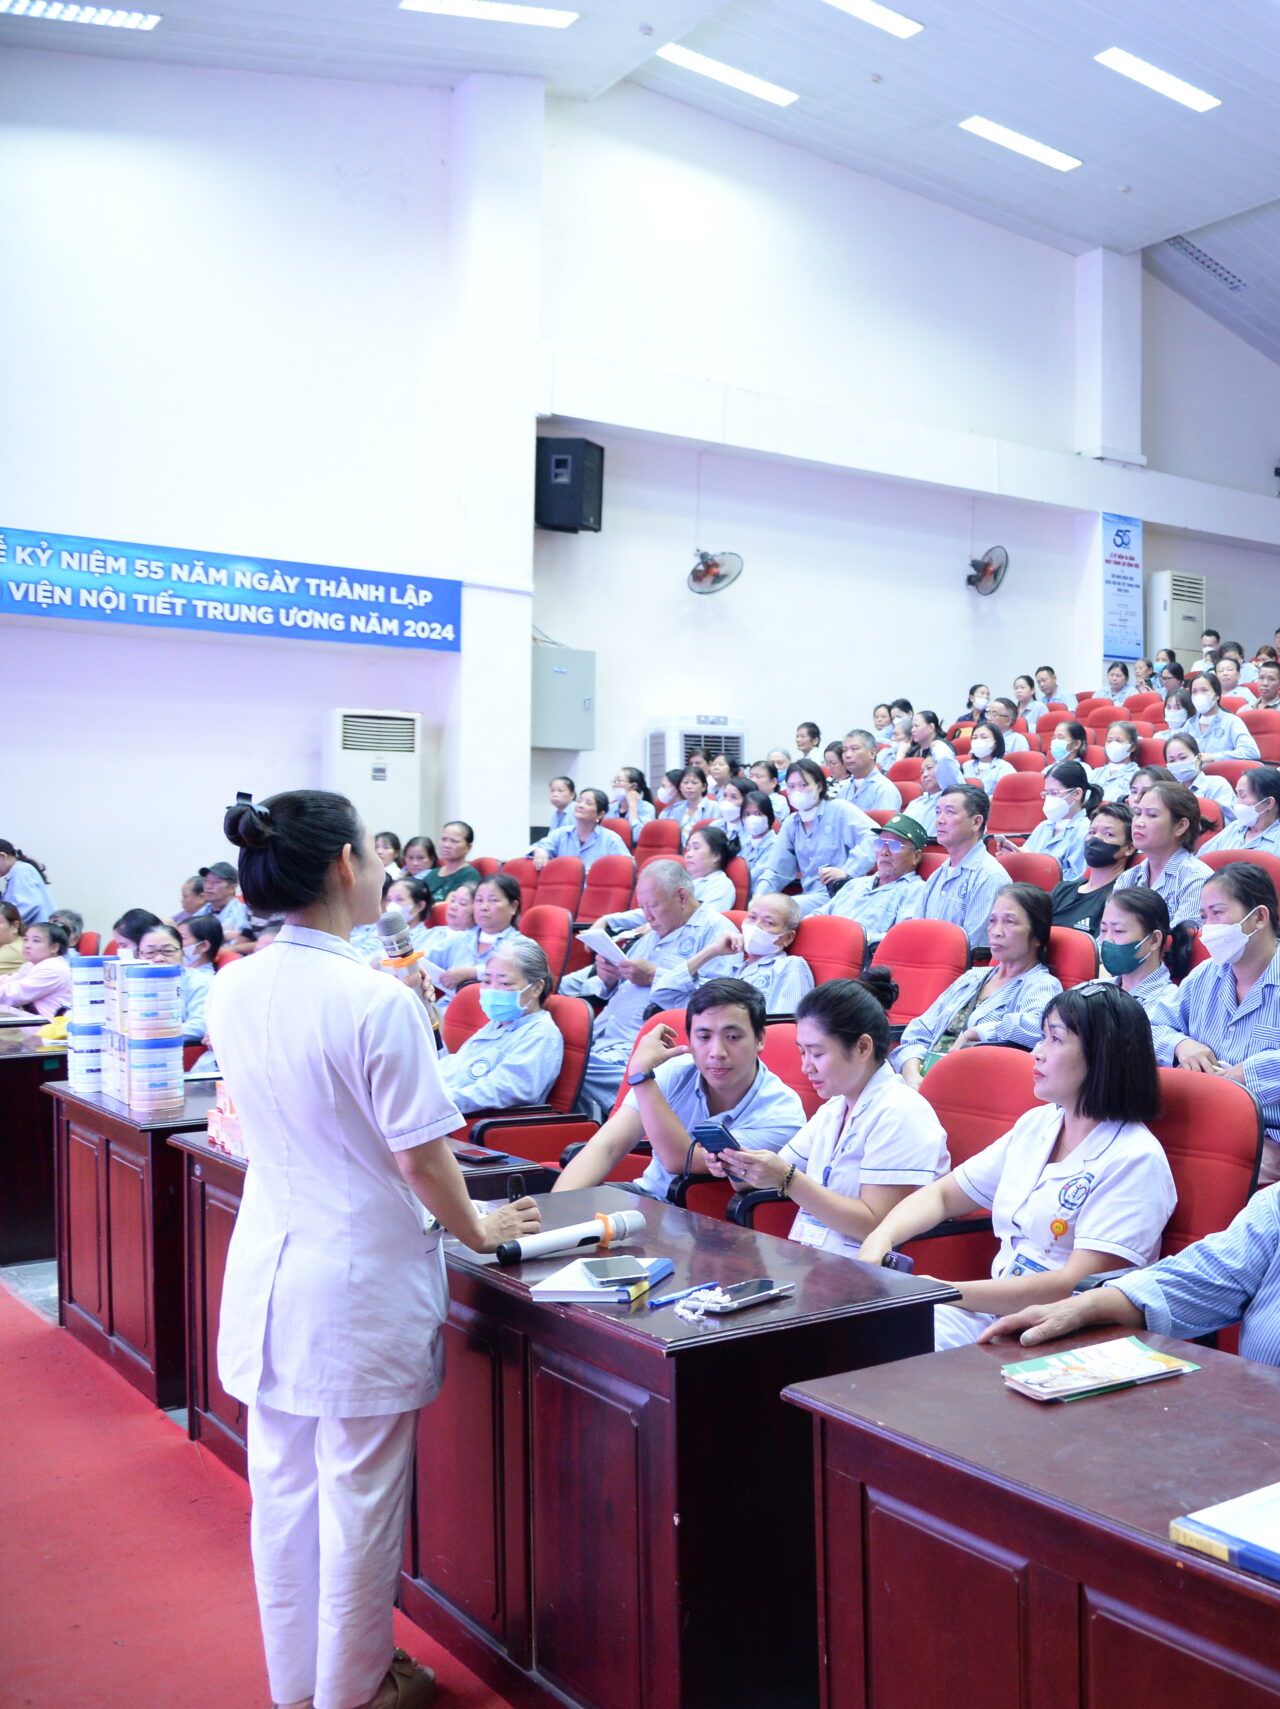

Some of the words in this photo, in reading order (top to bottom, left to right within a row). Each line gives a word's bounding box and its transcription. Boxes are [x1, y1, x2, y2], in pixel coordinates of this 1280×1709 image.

[15, 541, 54, 567] KỶ
[60, 549, 127, 577] NIỆM
[134, 559, 164, 580] 55
[171, 560, 228, 587] NĂM
[234, 569, 300, 594] NGÀY
[305, 576, 386, 603] THÀNH
[390, 584, 433, 609] LẬP
[8, 580, 72, 608] VIỆN
[79, 585, 126, 614] NỘI
[132, 589, 187, 616] TIẾT
[192, 599, 274, 625] TRUNG
[279, 606, 345, 631] ƯƠNG
[350, 612, 399, 636] NĂM
[403, 620, 455, 641] 2024
